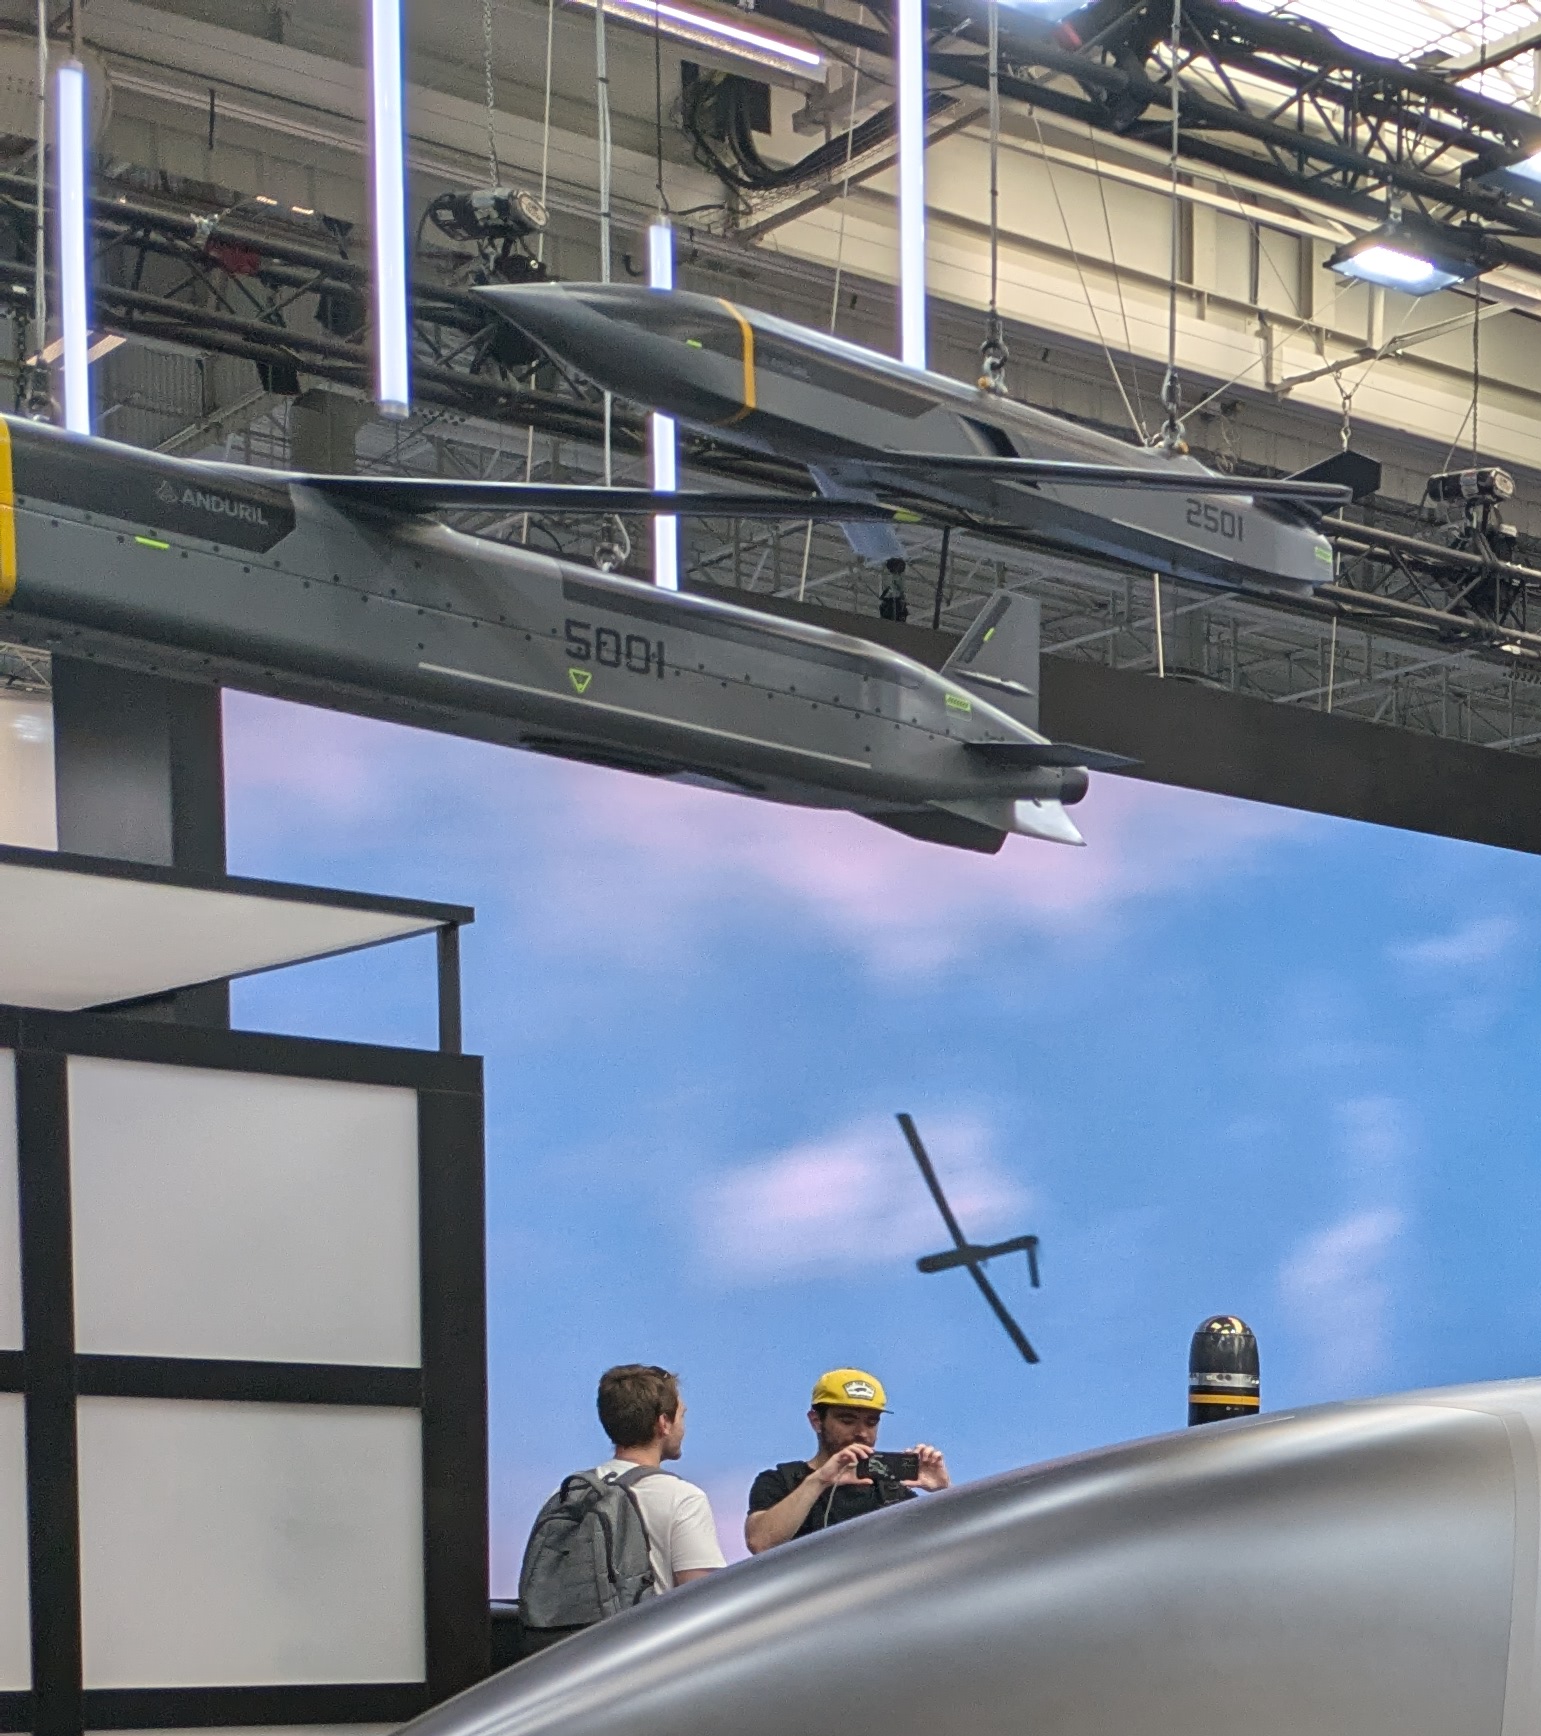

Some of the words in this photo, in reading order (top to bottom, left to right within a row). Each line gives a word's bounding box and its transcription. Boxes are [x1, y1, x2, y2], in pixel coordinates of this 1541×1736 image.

[181, 488, 268, 526] ANDURIL
[1186, 498, 1243, 541] 2501
[565, 619, 664, 679] 5001
